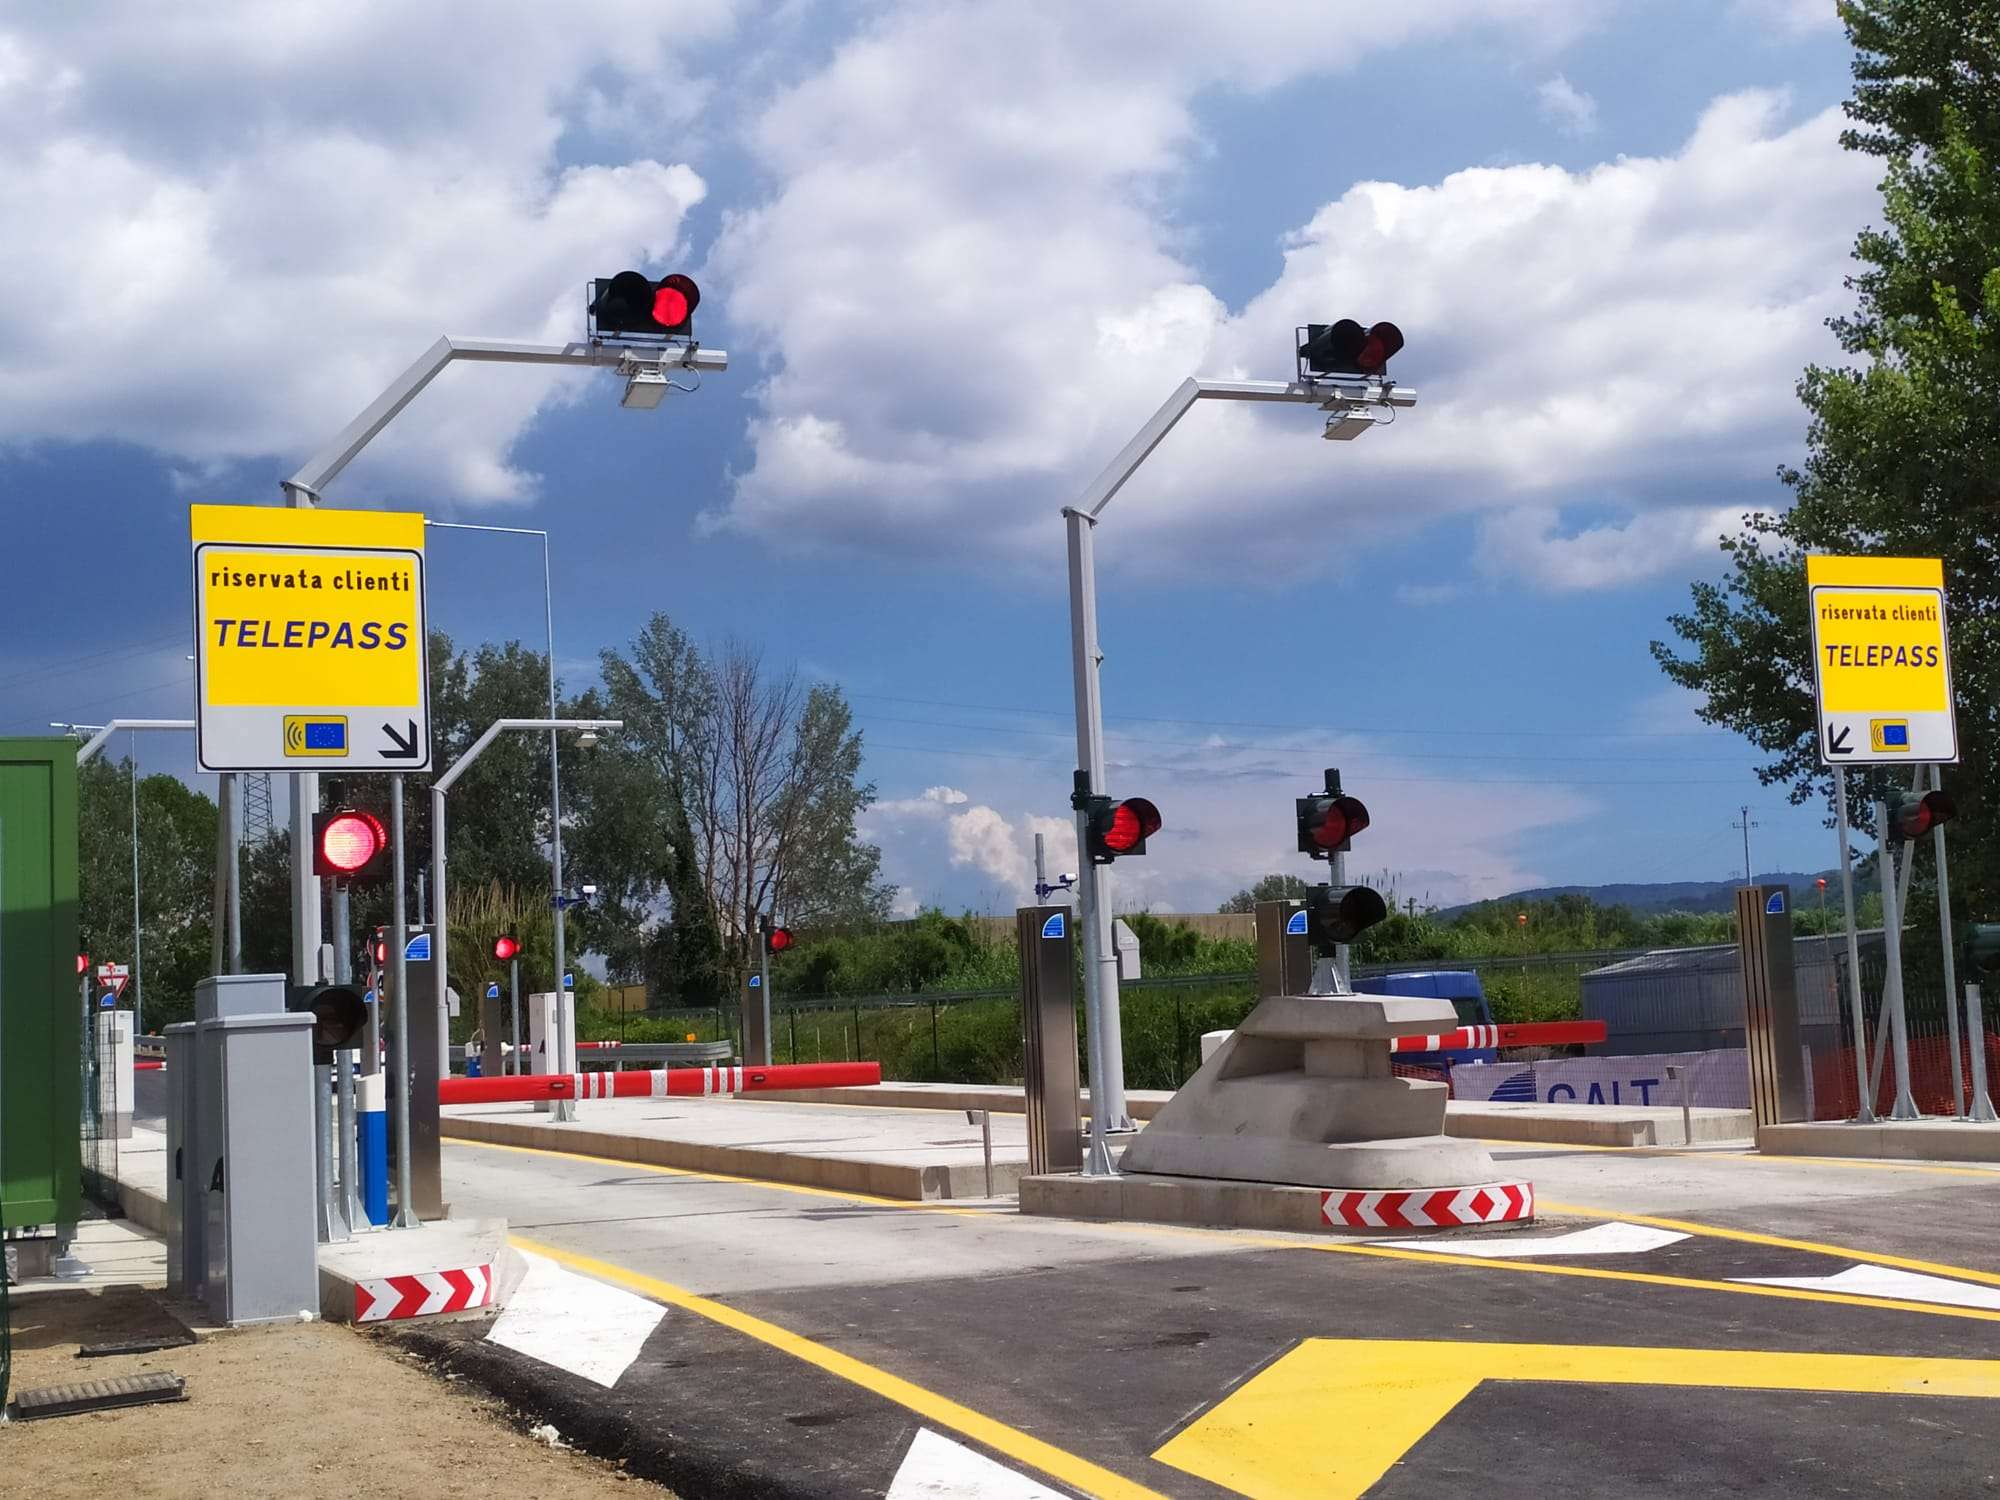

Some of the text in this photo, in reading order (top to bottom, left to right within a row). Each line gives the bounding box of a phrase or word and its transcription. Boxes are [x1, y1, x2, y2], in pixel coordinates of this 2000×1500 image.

[211, 567, 409, 591] riservata clienti
[1821, 604, 1937, 621] riservata clienti
[213, 619, 409, 650] TELEPASS
[1825, 645, 1938, 667] TELEPASS
